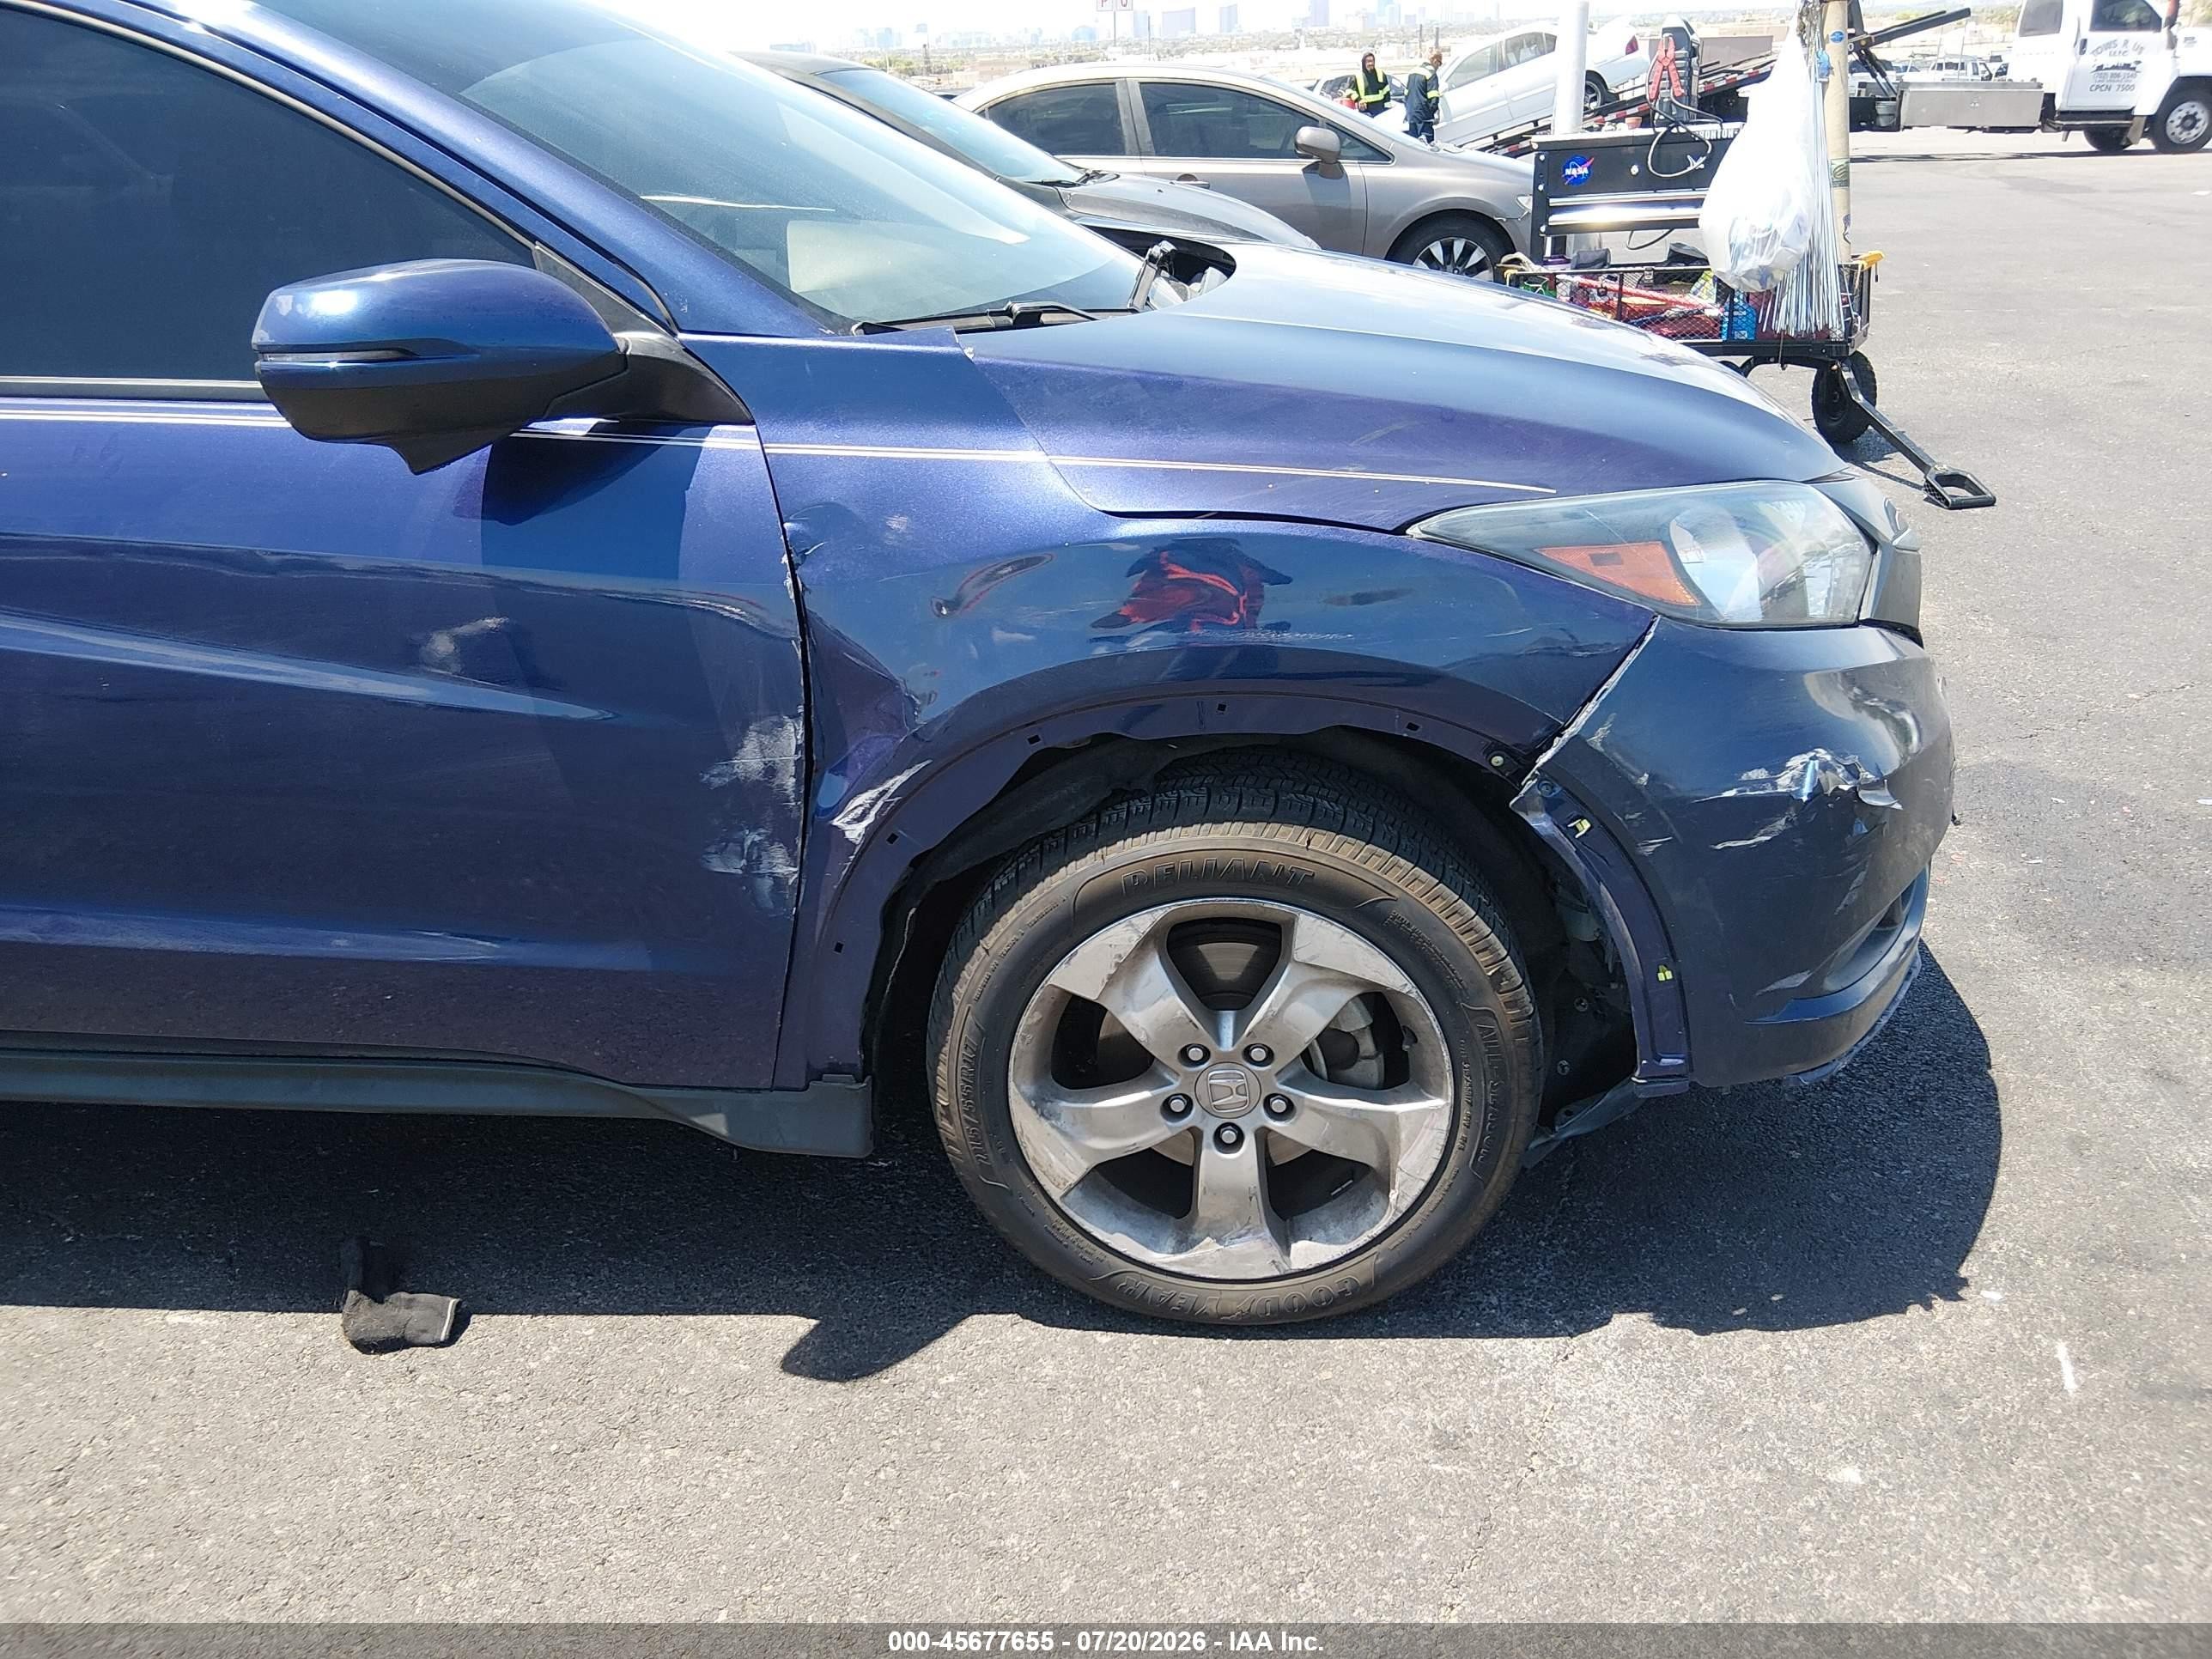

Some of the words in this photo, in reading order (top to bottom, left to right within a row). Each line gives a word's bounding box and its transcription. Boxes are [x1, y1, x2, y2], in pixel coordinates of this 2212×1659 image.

[2122, 39, 2130, 49] R
[2089, 83, 2112, 92] CPCN
[2115, 83, 2136, 92] 7500
[1565, 167, 1589, 175] NASA
[1121, 857, 1315, 896] RELIANT
